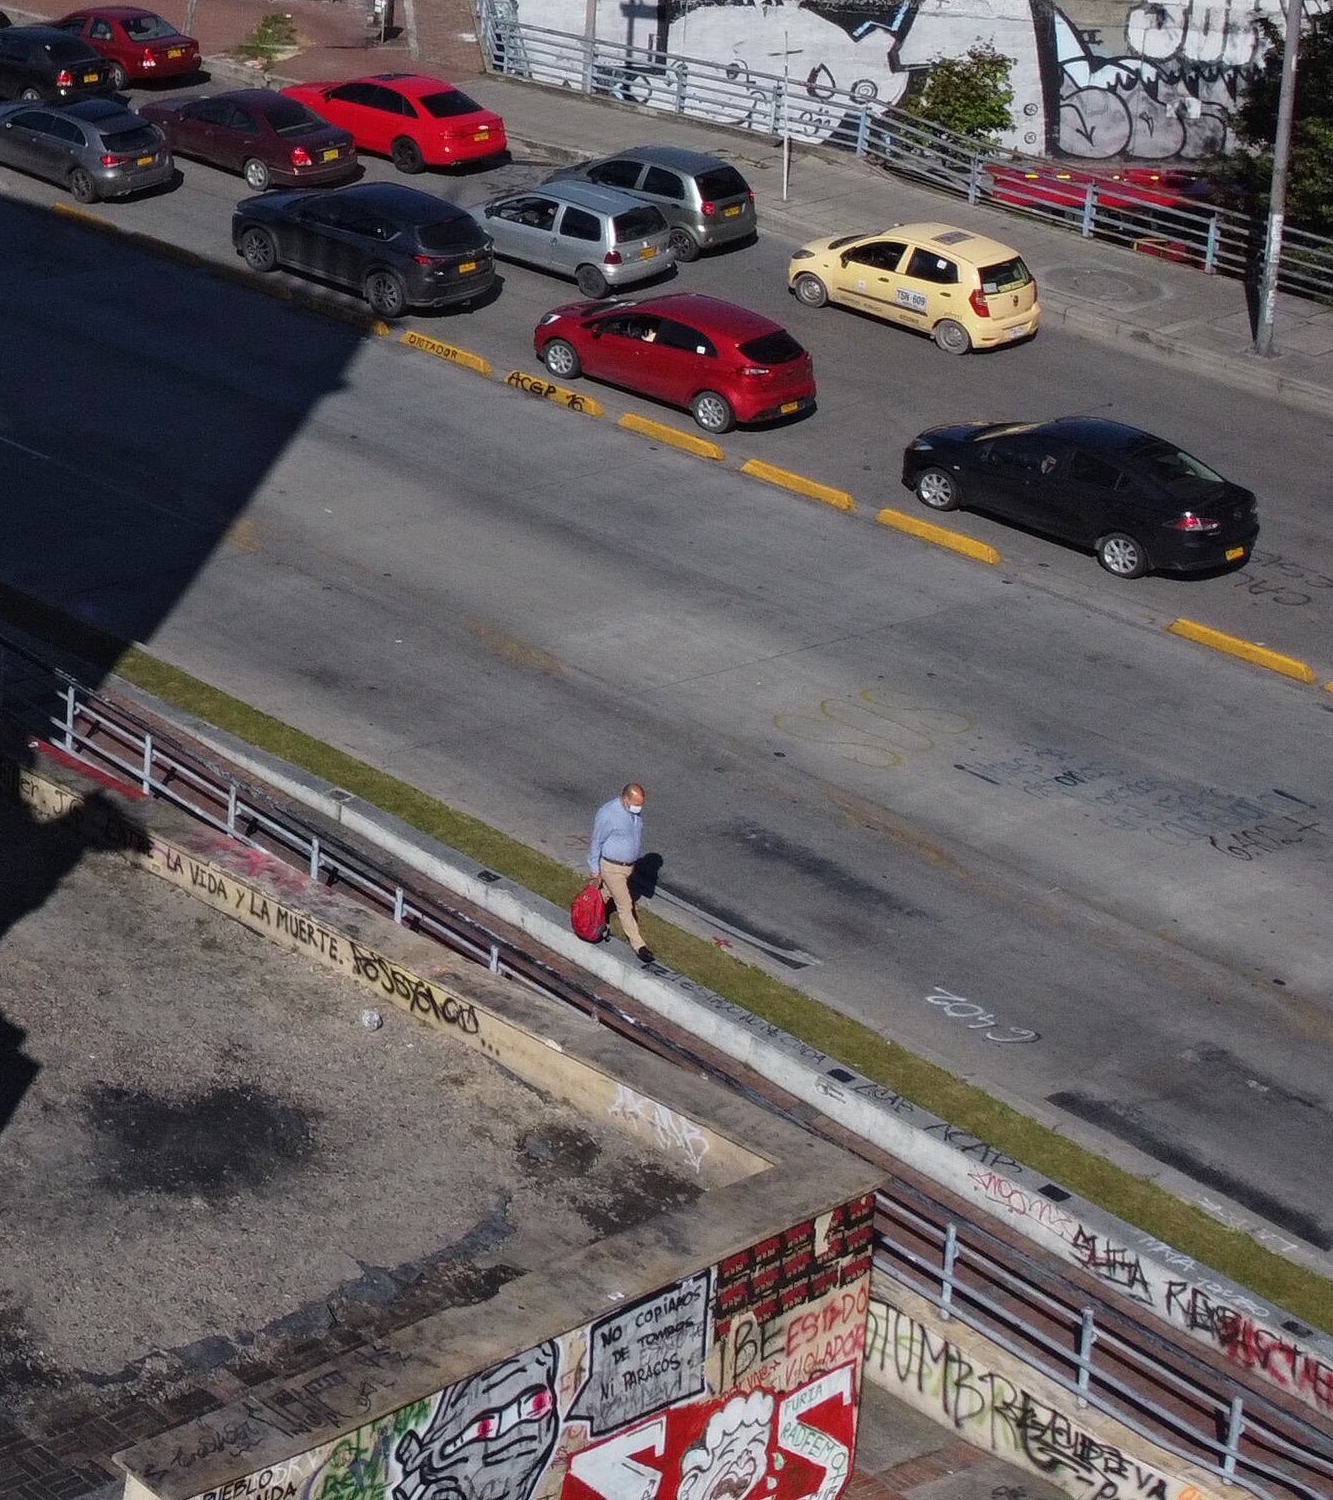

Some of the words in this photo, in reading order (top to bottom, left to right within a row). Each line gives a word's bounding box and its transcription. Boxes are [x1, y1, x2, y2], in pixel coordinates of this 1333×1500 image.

[166, 846, 186, 872] LA
[189, 864, 228, 902] VIDA
[250, 891, 272, 923] LA
[785, 1285, 869, 1356] ESTADO
[601, 1325, 623, 1348] NO
[612, 1349, 629, 1365] DE
[784, 1388, 823, 1413] FURIA
